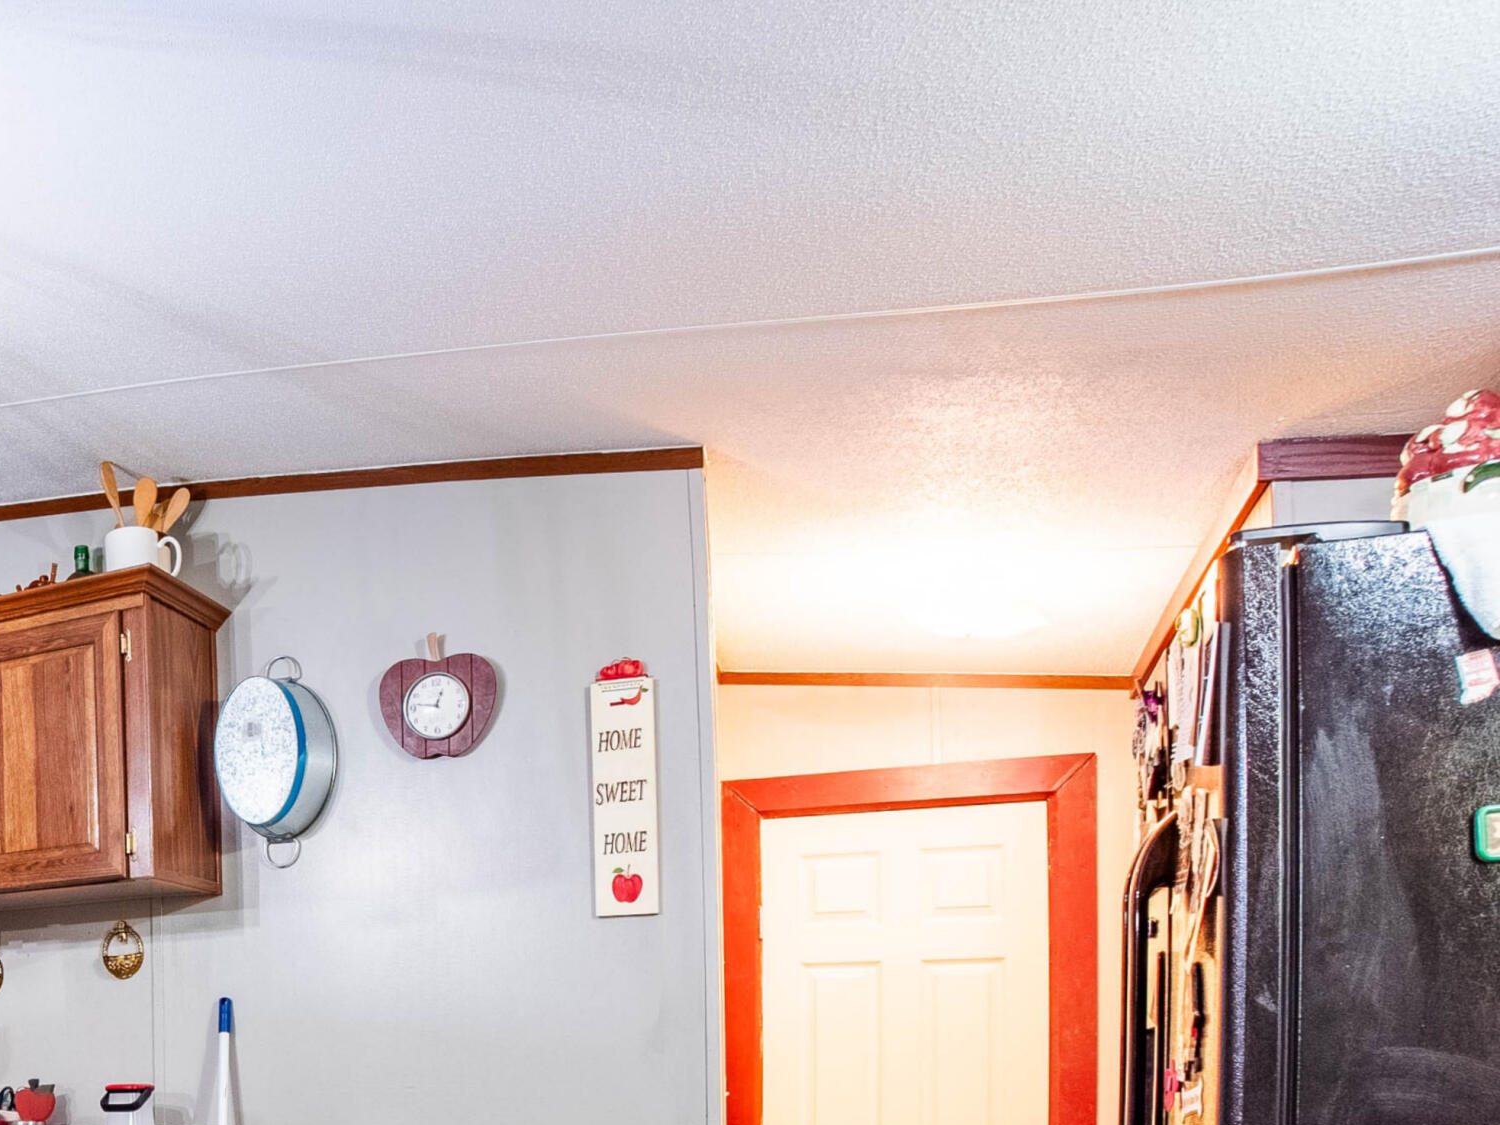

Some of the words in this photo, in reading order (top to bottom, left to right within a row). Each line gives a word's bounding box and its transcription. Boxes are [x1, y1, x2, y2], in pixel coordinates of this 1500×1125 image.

[431, 678, 442, 687] 12
[434, 726, 442, 735] 6
[598, 728, 642, 752] HOME
[596, 779, 647, 805] SWEET
[603, 830, 647, 855] HOME
